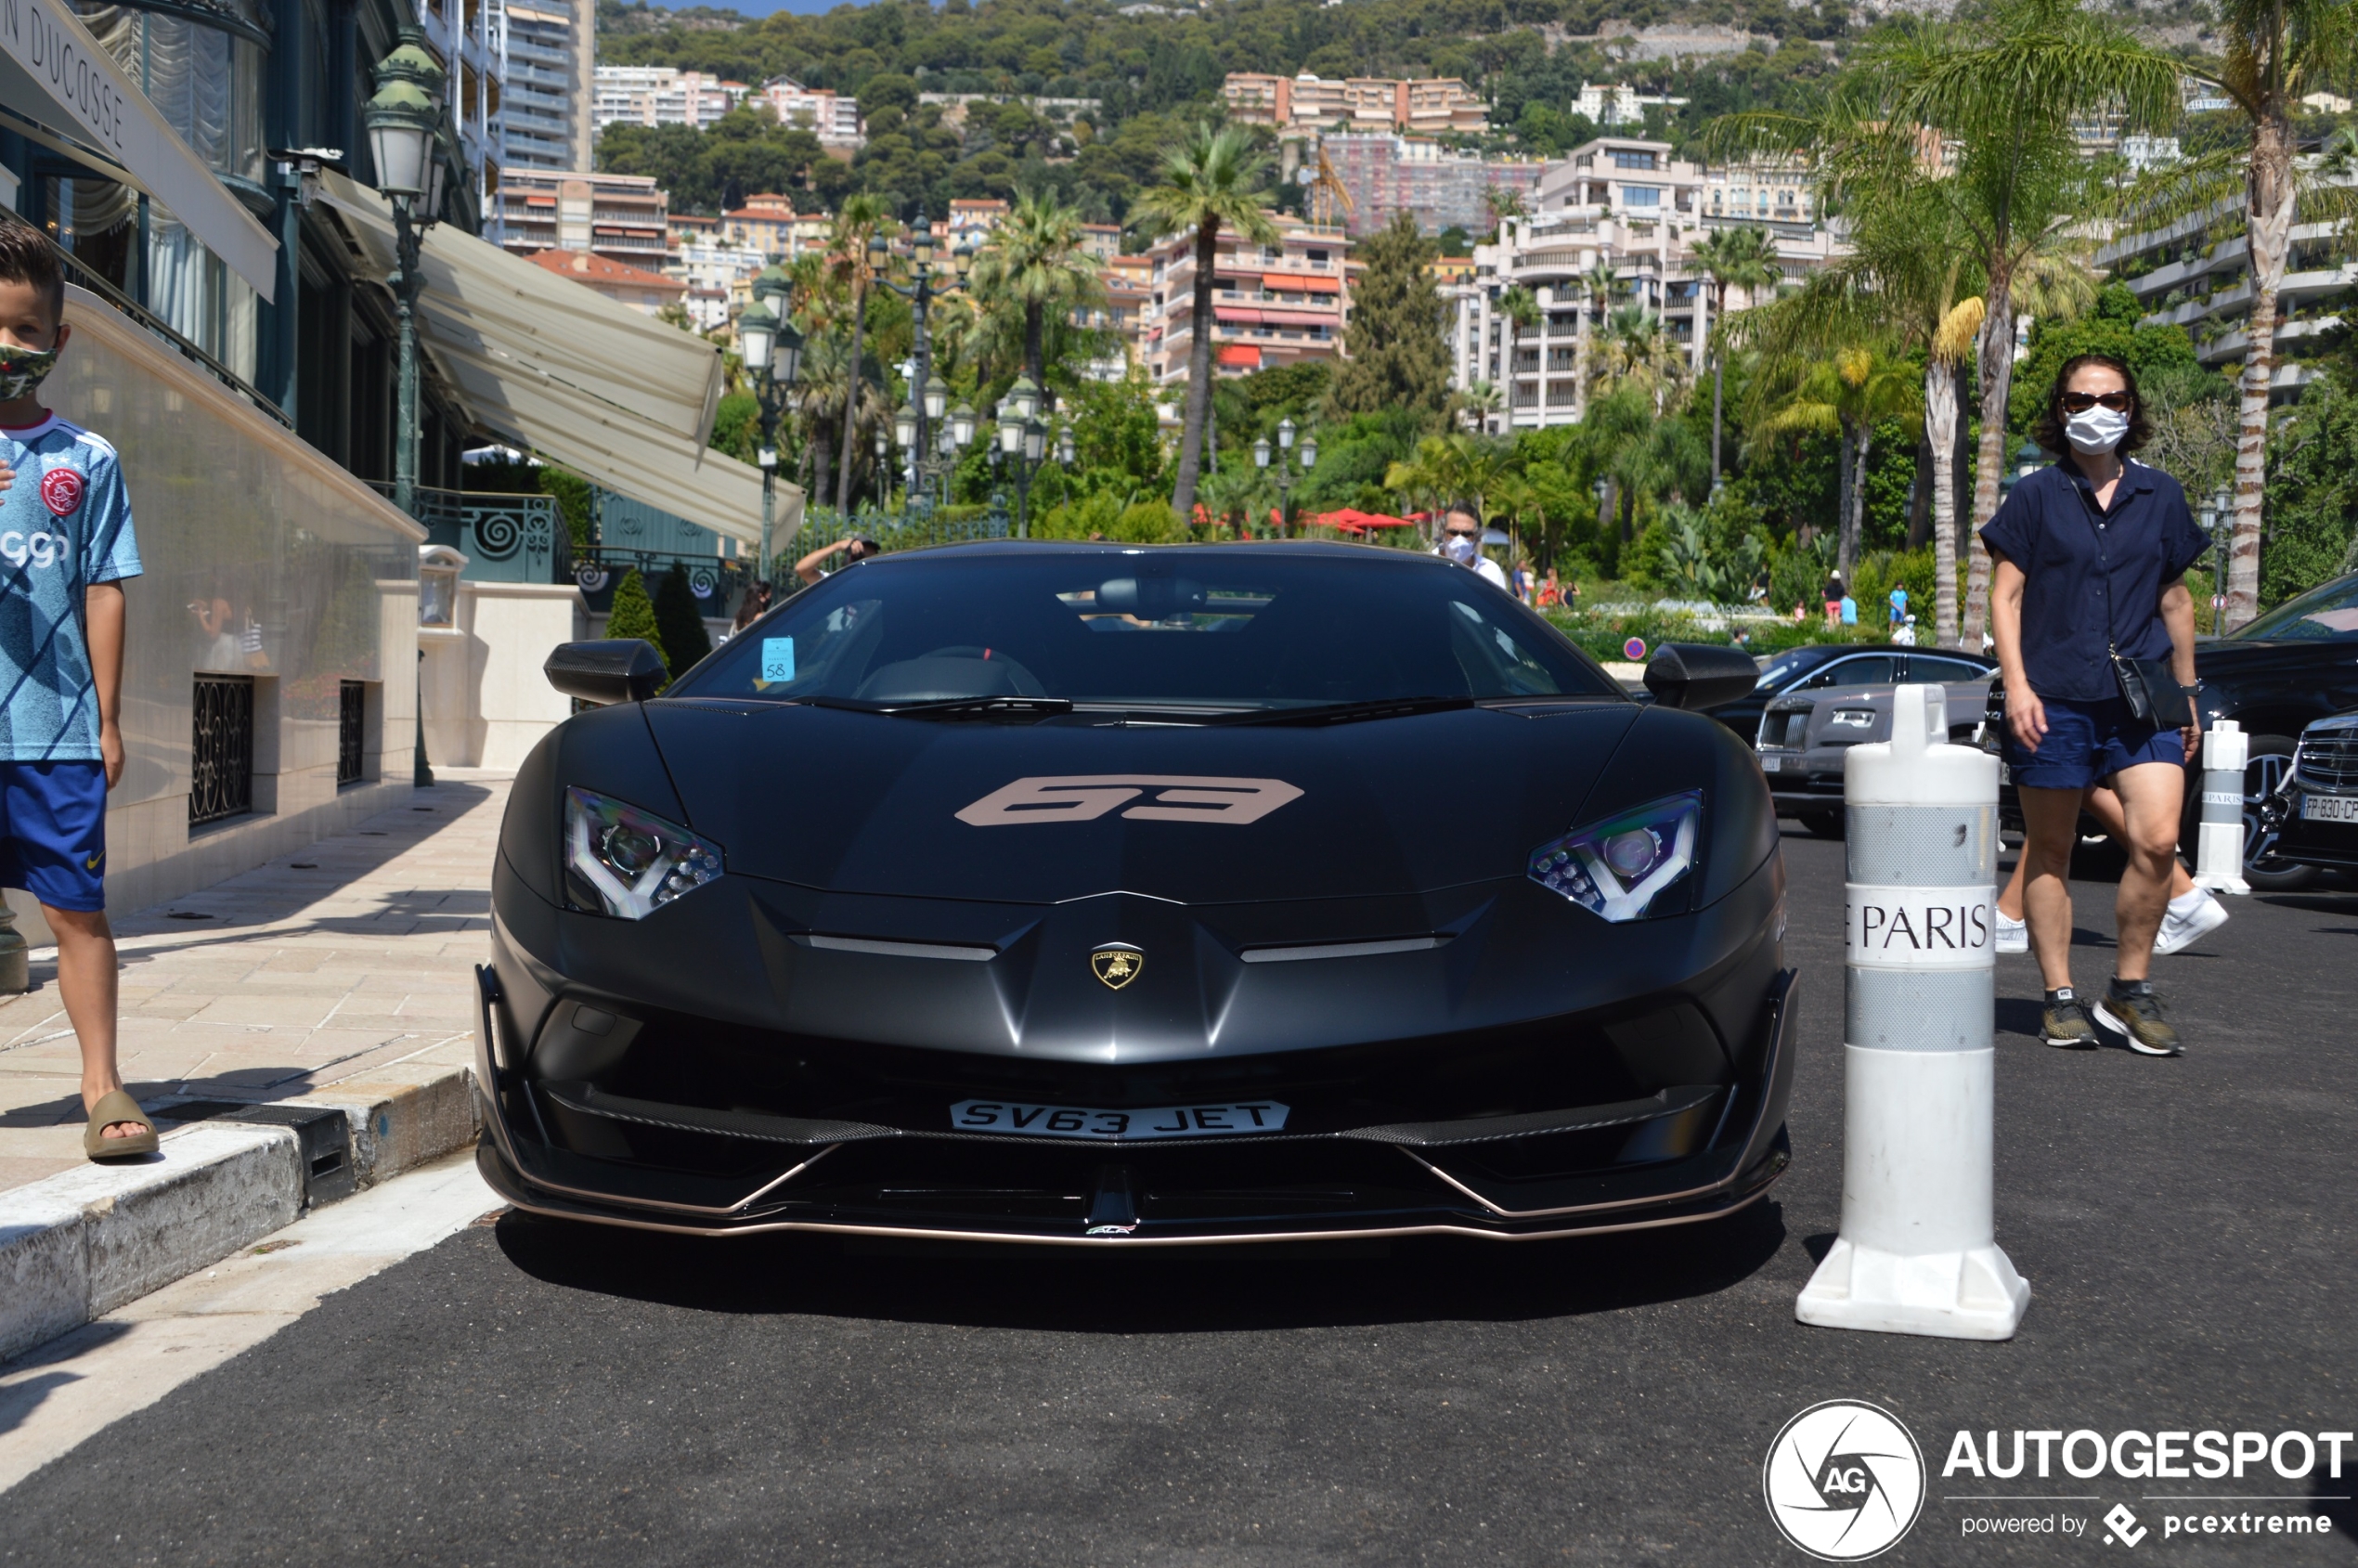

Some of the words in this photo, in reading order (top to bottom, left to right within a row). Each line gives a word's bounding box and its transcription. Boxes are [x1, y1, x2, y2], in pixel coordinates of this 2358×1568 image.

[44, 470, 66, 487] AJAX
[767, 663, 785, 679] 58
[954, 773, 1305, 826] 63
[2209, 794, 2242, 805] PARIS
[1863, 904, 1987, 949] PARIS
[961, 1105, 1130, 1134] SV63
[1153, 1105, 1272, 1133] JET
